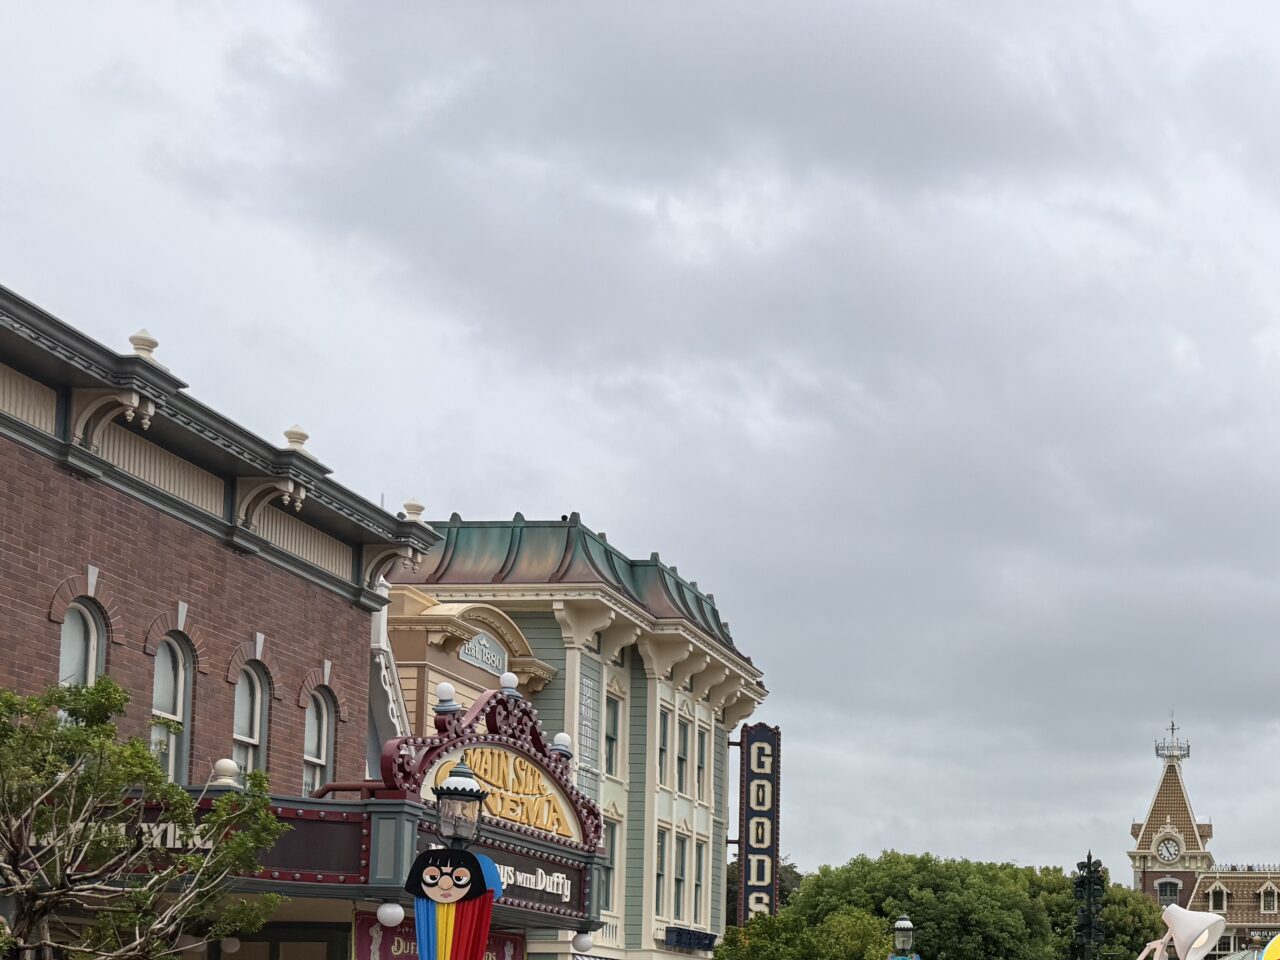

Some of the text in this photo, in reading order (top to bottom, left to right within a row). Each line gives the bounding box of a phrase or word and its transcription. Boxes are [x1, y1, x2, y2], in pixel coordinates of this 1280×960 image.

[482, 649, 502, 669] 1880
[464, 748, 510, 791] MAIN
[747, 741, 773, 918] GOODS
[535, 868, 572, 902] Duffy
